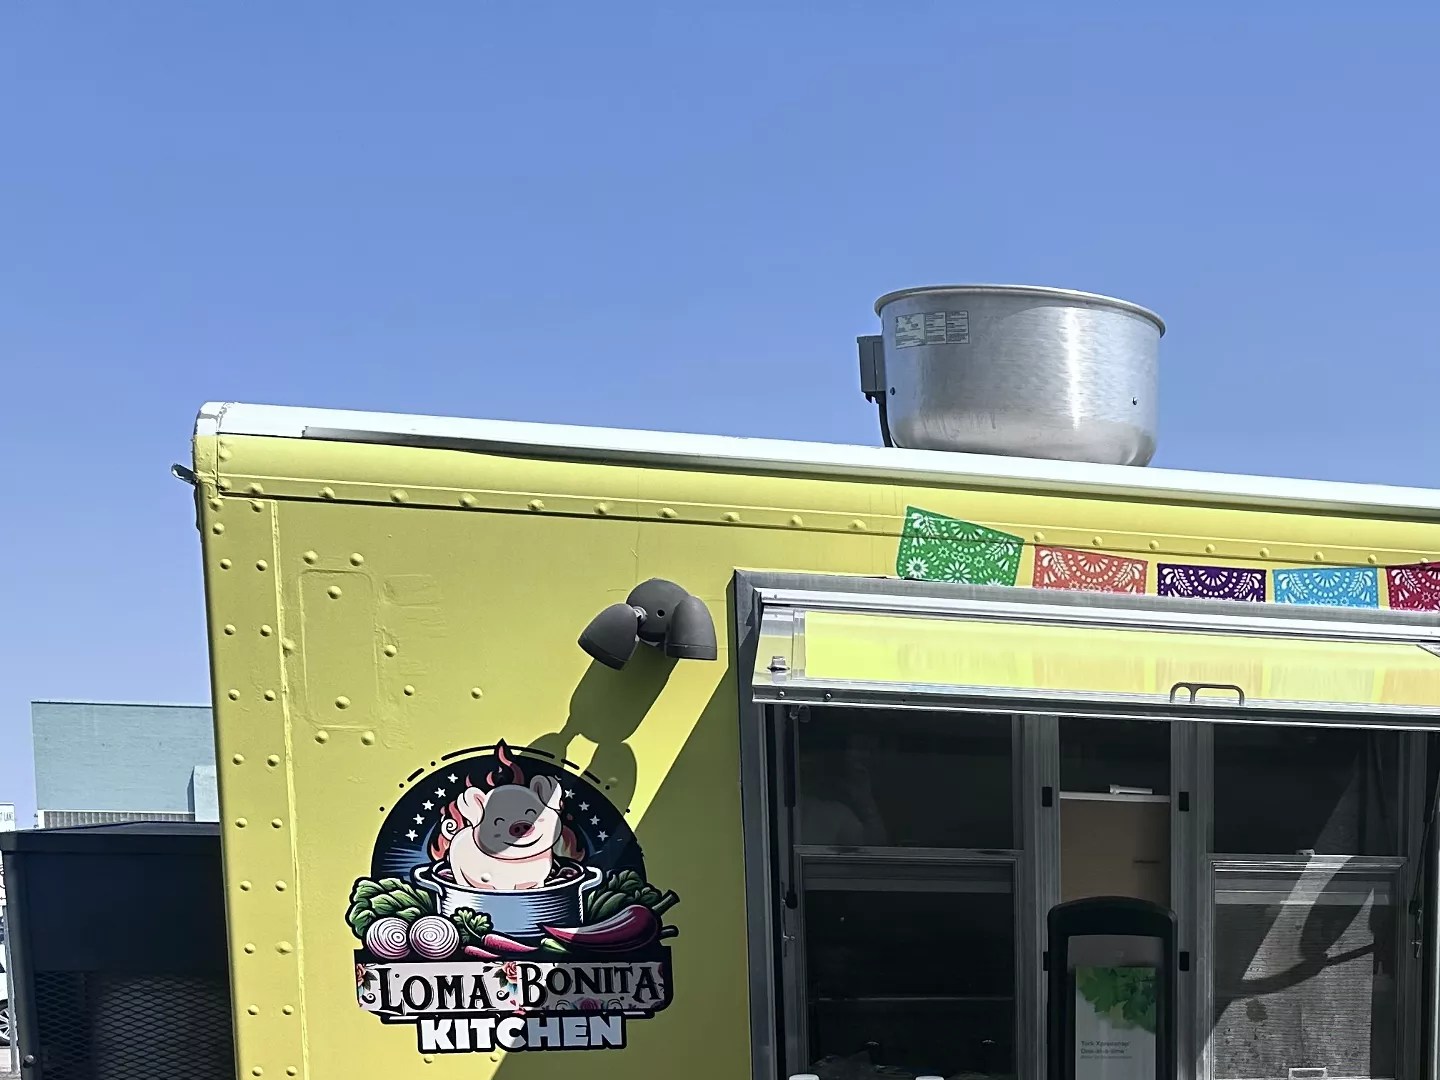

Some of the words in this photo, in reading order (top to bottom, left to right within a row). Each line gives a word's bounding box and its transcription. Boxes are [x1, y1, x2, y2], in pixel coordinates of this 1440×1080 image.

[376, 966, 495, 1013] LOMA
[520, 966, 662, 1010] BONITA
[420, 1015, 625, 1050] KITCHEN
